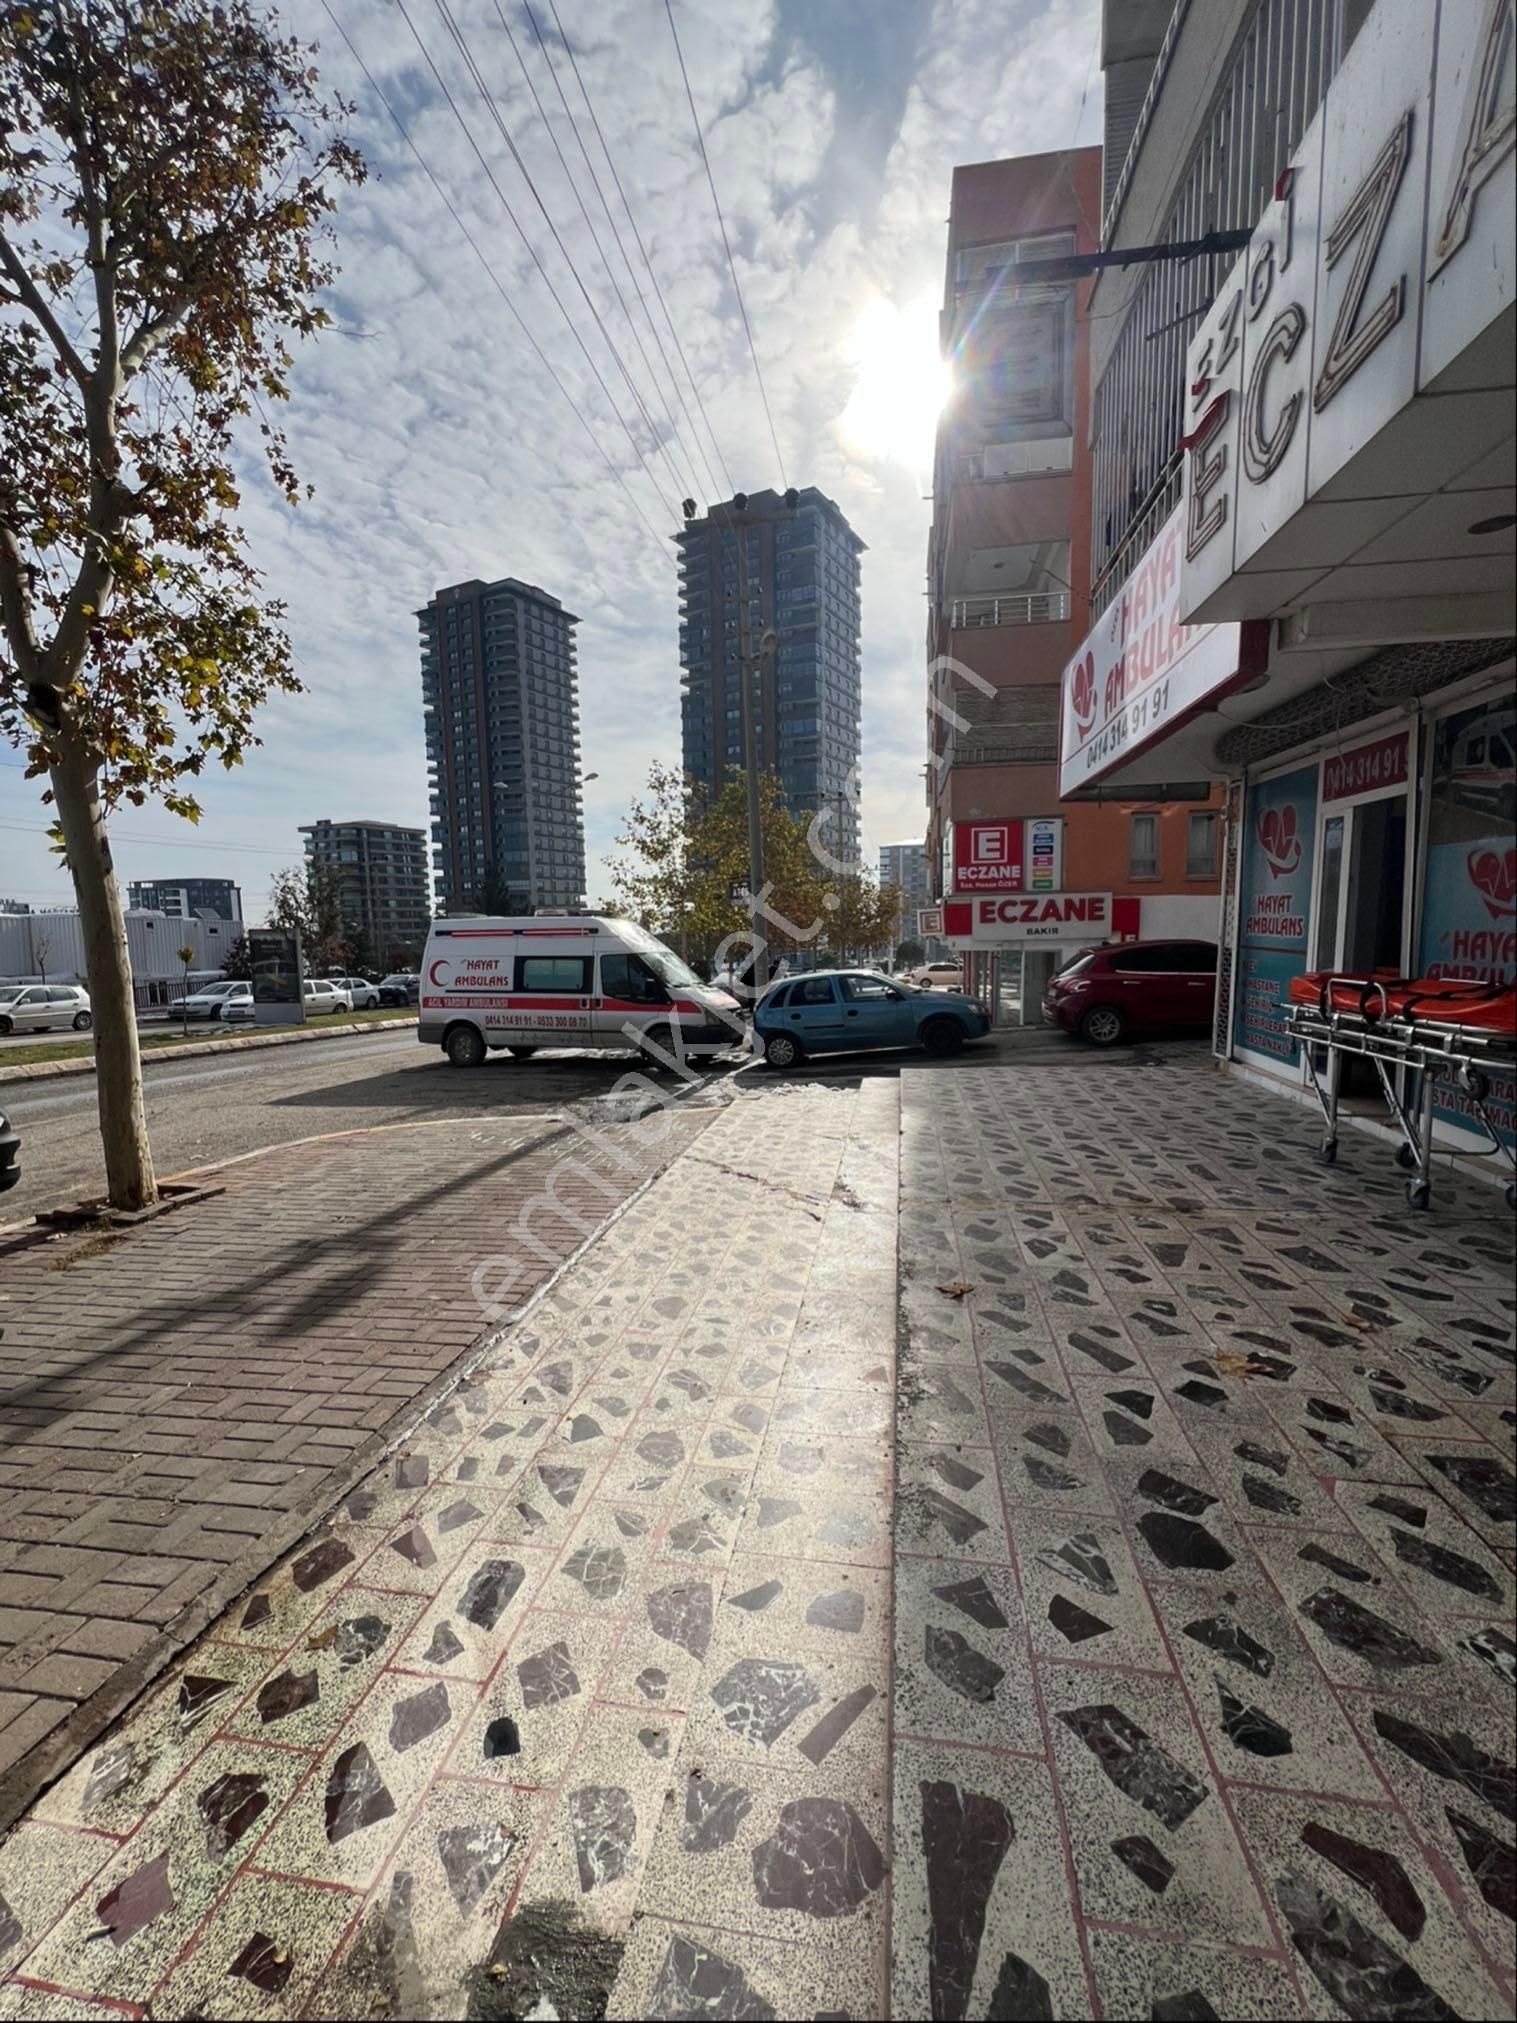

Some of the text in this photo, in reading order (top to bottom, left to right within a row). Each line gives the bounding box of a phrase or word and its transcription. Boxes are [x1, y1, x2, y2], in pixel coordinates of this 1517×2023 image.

[1120, 518, 1184, 649] HAYA
[1132, 697, 1148, 735] 91
[1152, 678, 1170, 720] 91
[1383, 744, 1401, 779] 91
[978, 831, 1001, 859] E
[957, 865, 1021, 880] ECZANE
[979, 897, 1105, 924] ECZANE
[1257, 894, 1293, 914] HAYAT
[1026, 927, 1059, 936] BAKIR
[1246, 916, 1304, 937] AMBULANS
[467, 959, 500, 971] HAYAT
[455, 976, 509, 987] AMBULANS
